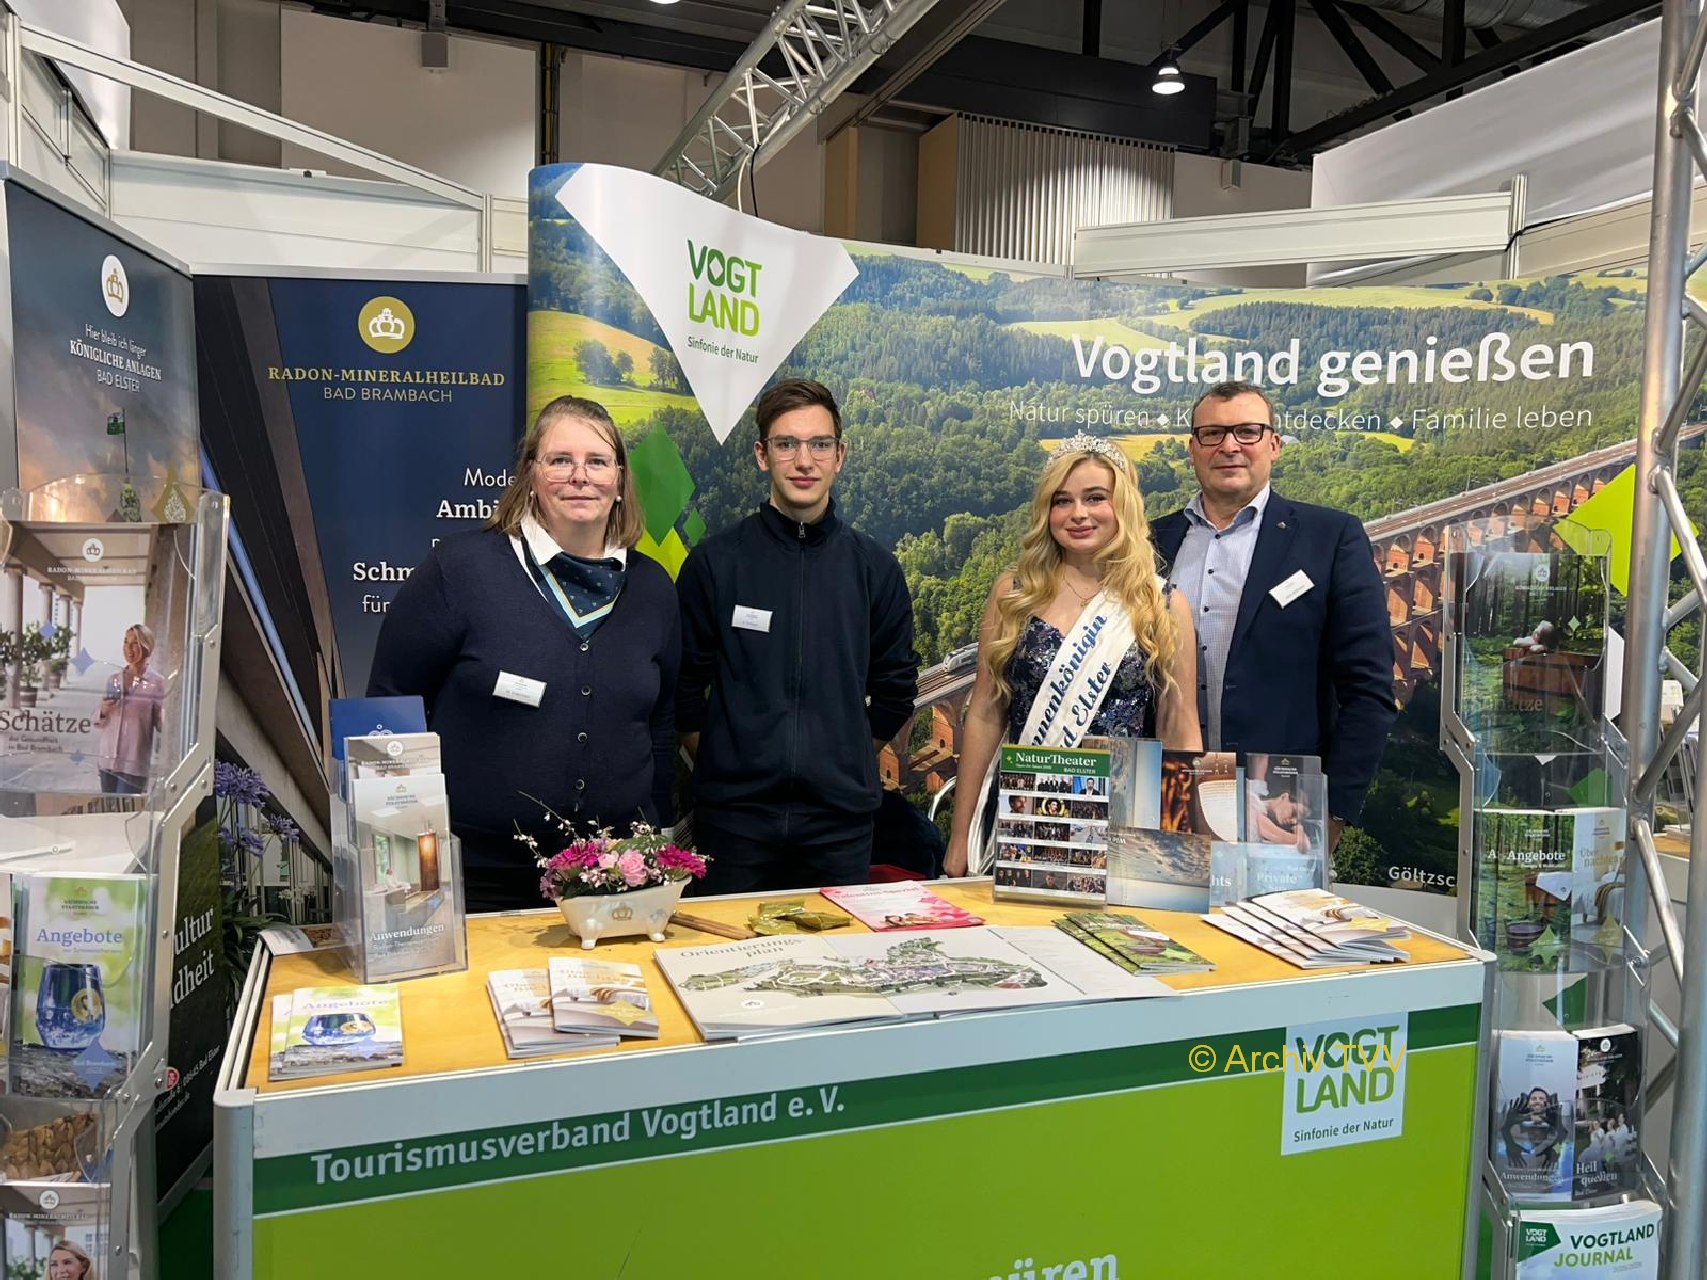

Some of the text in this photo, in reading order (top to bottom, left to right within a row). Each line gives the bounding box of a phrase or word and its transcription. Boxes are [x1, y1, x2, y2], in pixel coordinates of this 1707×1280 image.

[687, 239, 762, 298] VOGT
[689, 282, 760, 337] LAND
[85, 323, 101, 340] Hier
[100, 329, 118, 347] bleib
[118, 337, 127, 350] ich
[687, 336, 759, 364] Sinfonie der Natur
[69, 339, 162, 381] KÖNIGLICHE ANLAGEN
[1072, 332, 1594, 397] Vogtland genießen
[97, 369, 140, 393] BAD ELSTER
[268, 367, 505, 386] RADON-MINERALHEILBAD
[324, 387, 453, 403] BAD BRAMBACH
[1075, 401, 1149, 428] spüren
[1276, 404, 1594, 432] ntdecken Familie leben
[362, 594, 391, 613] für
[1072, 662, 1111, 727] Elster
[0, 709, 91, 734] Schätze
[1015, 752, 1097, 766] NaturTheater
[1507, 850, 1567, 863] Angebote
[37, 928, 123, 947] Angebote
[174, 907, 214, 955] ultur
[369, 922, 444, 942] Anwendungen
[171, 949, 215, 1009] dheit
[1295, 1025, 1400, 1073] VOGT
[1296, 1066, 1395, 1114] LAND
[312, 1086, 845, 1185] Tourismusverband Vogtland e. V.
[1294, 1118, 1395, 1143] Sinfonie der Natur
[1525, 1228, 1548, 1236] VOGT
[1525, 1235, 1547, 1243] LAND
[1571, 1223, 1655, 1250] VOGTLAND
[990, 1254, 1118, 1280] üren
[1554, 1247, 1634, 1268] JOURNAL
